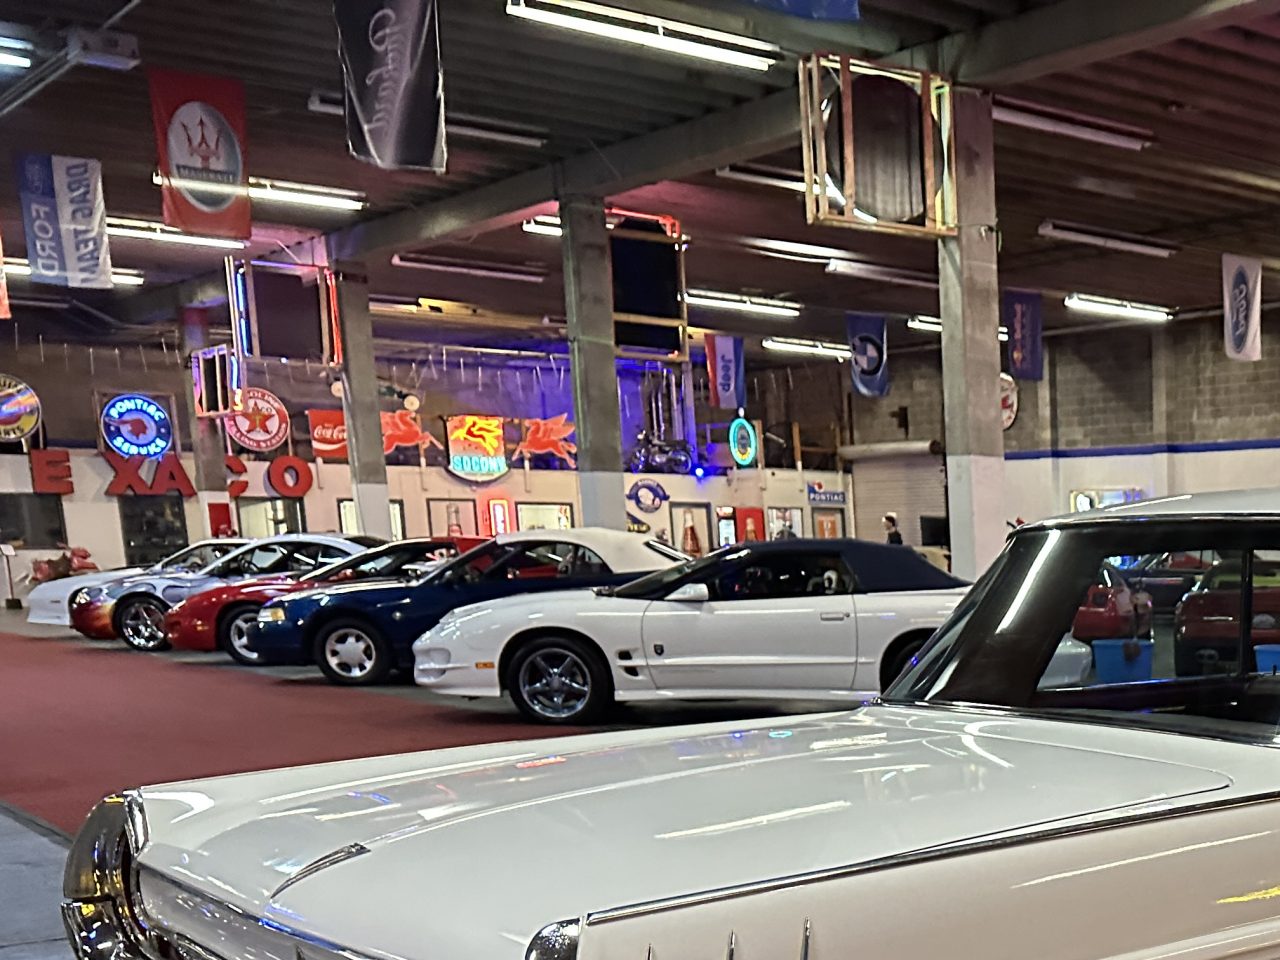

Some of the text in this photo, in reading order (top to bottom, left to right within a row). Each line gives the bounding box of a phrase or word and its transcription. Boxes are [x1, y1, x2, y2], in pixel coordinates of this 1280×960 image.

[719, 354, 733, 392] Jeep
[109, 398, 166, 422] PONTIAC
[112, 436, 167, 455] SERVICE
[453, 455, 507, 473] SOCONY
[810, 491, 844, 502] PONTIAC
